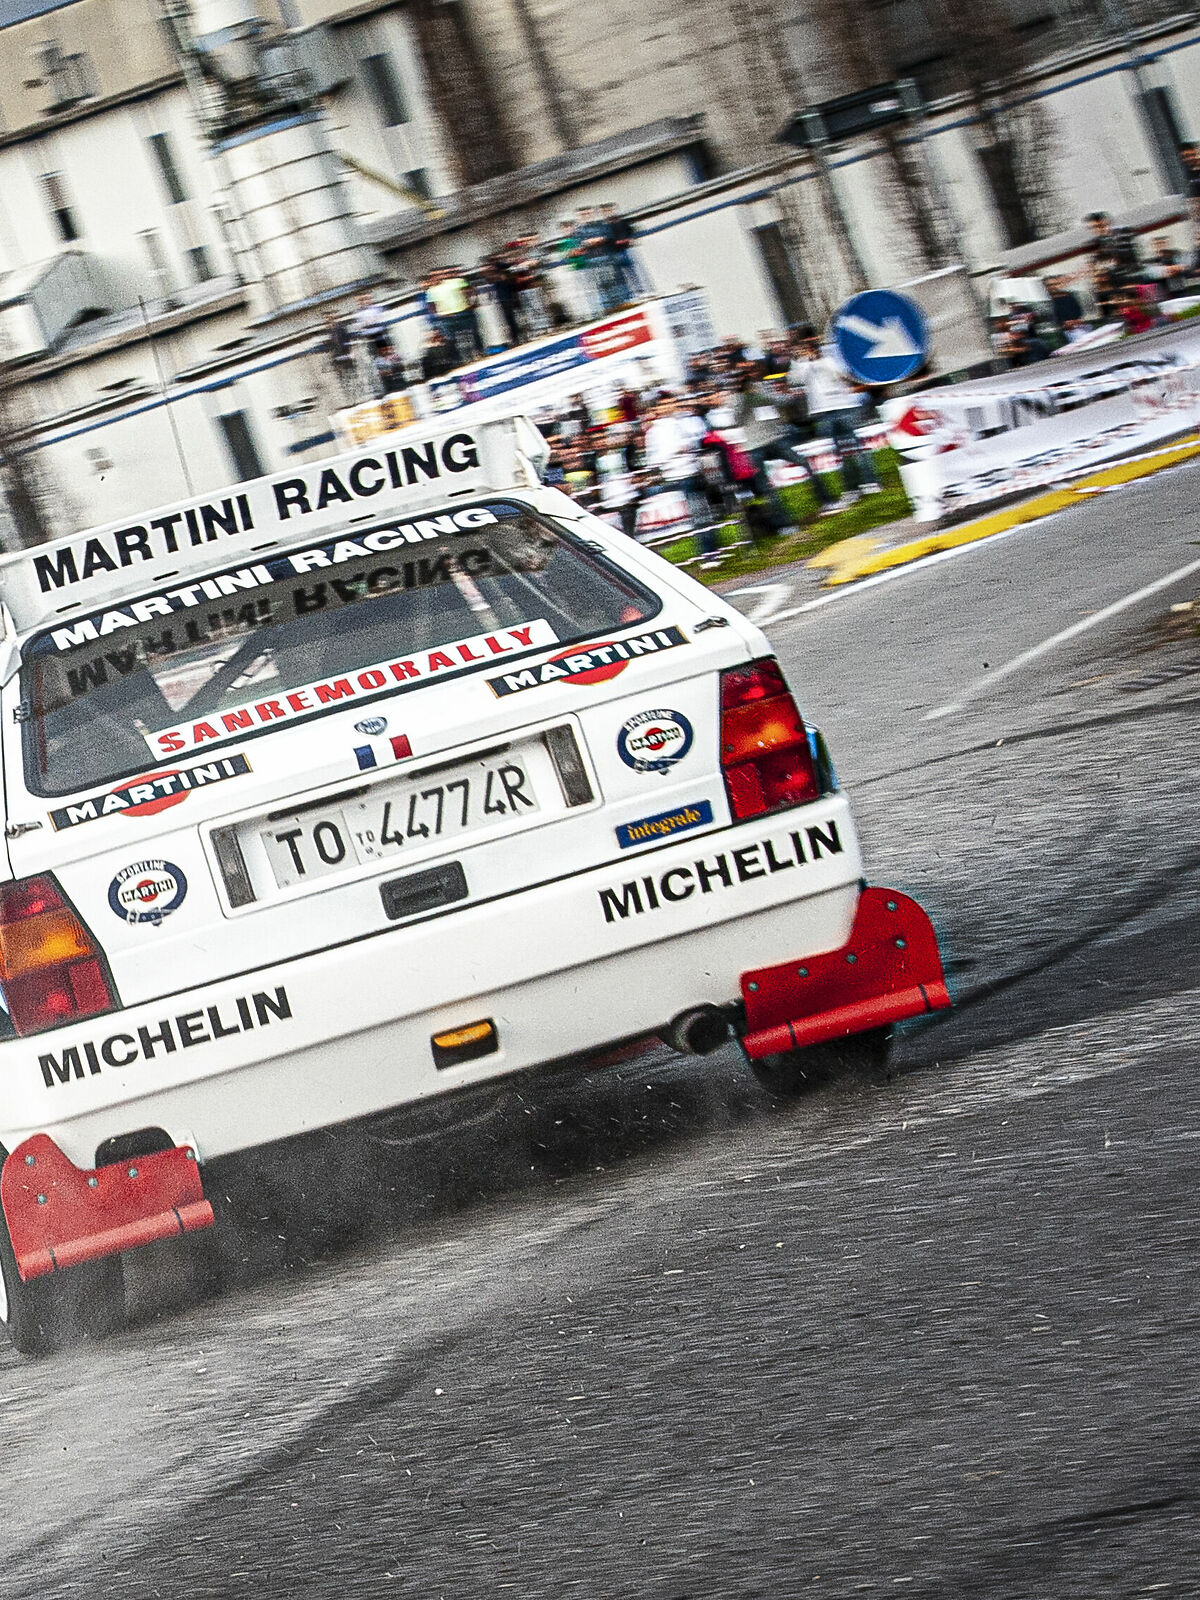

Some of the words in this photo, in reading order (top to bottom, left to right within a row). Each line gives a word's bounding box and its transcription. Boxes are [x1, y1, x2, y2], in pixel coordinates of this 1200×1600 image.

[33, 494, 254, 593] MARTINI
[272, 433, 480, 520] RACING
[50, 564, 275, 651] MARTINI
[287, 508, 499, 574] RACING
[157, 626, 535, 753] SANREMORALLY
[503, 631, 674, 691] MARTINI
[630, 727, 682, 751] MARTINI
[66, 759, 236, 824] MARTINI
[627, 808, 702, 840] integrale
[276, 820, 346, 876] TO
[597, 819, 845, 923] MICHELIN
[121, 879, 175, 903] MARTINI
[37, 985, 294, 1088] MICHELIN
